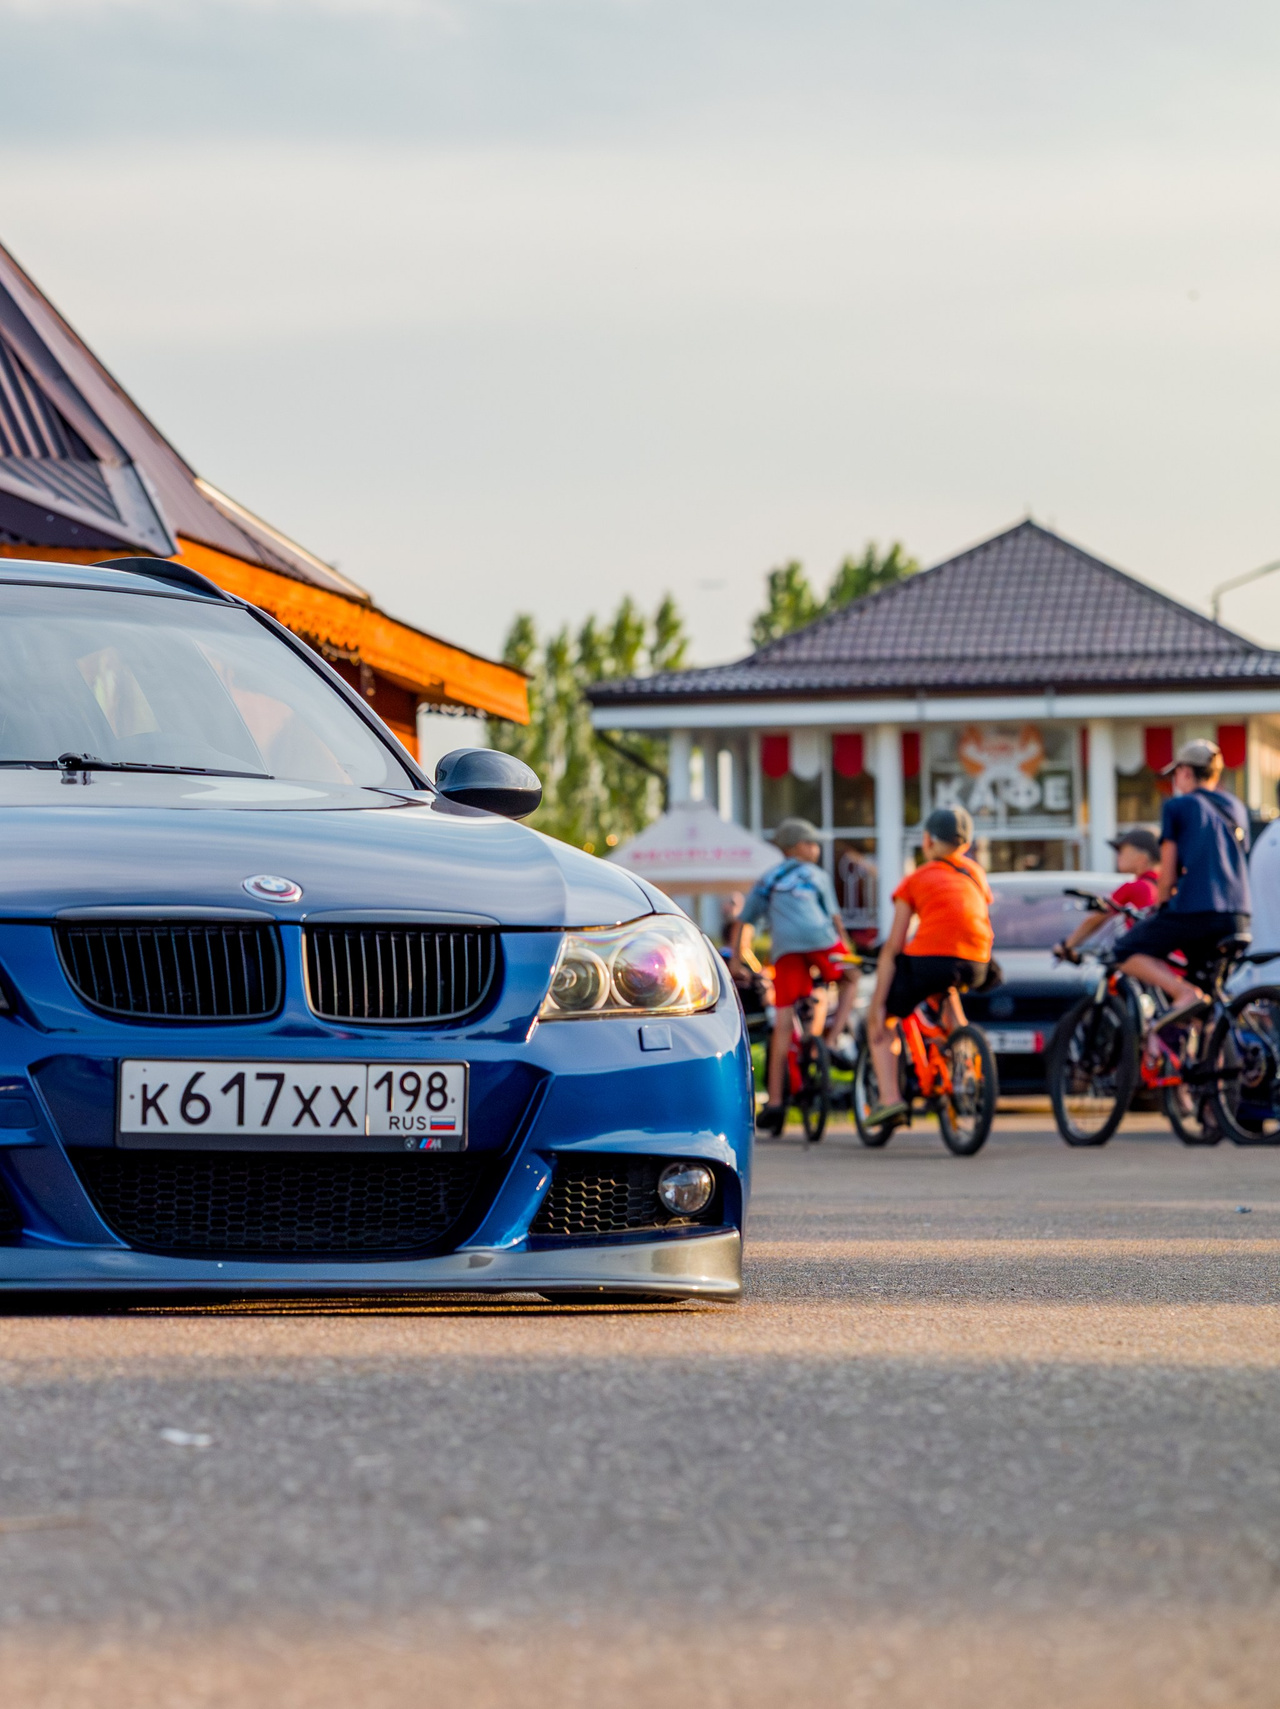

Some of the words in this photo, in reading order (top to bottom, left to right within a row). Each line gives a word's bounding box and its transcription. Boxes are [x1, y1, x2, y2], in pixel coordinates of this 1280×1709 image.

[936, 775, 1070, 811] КАФЕ
[374, 1071, 448, 1112] 198
[389, 1116, 427, 1130] RUS
